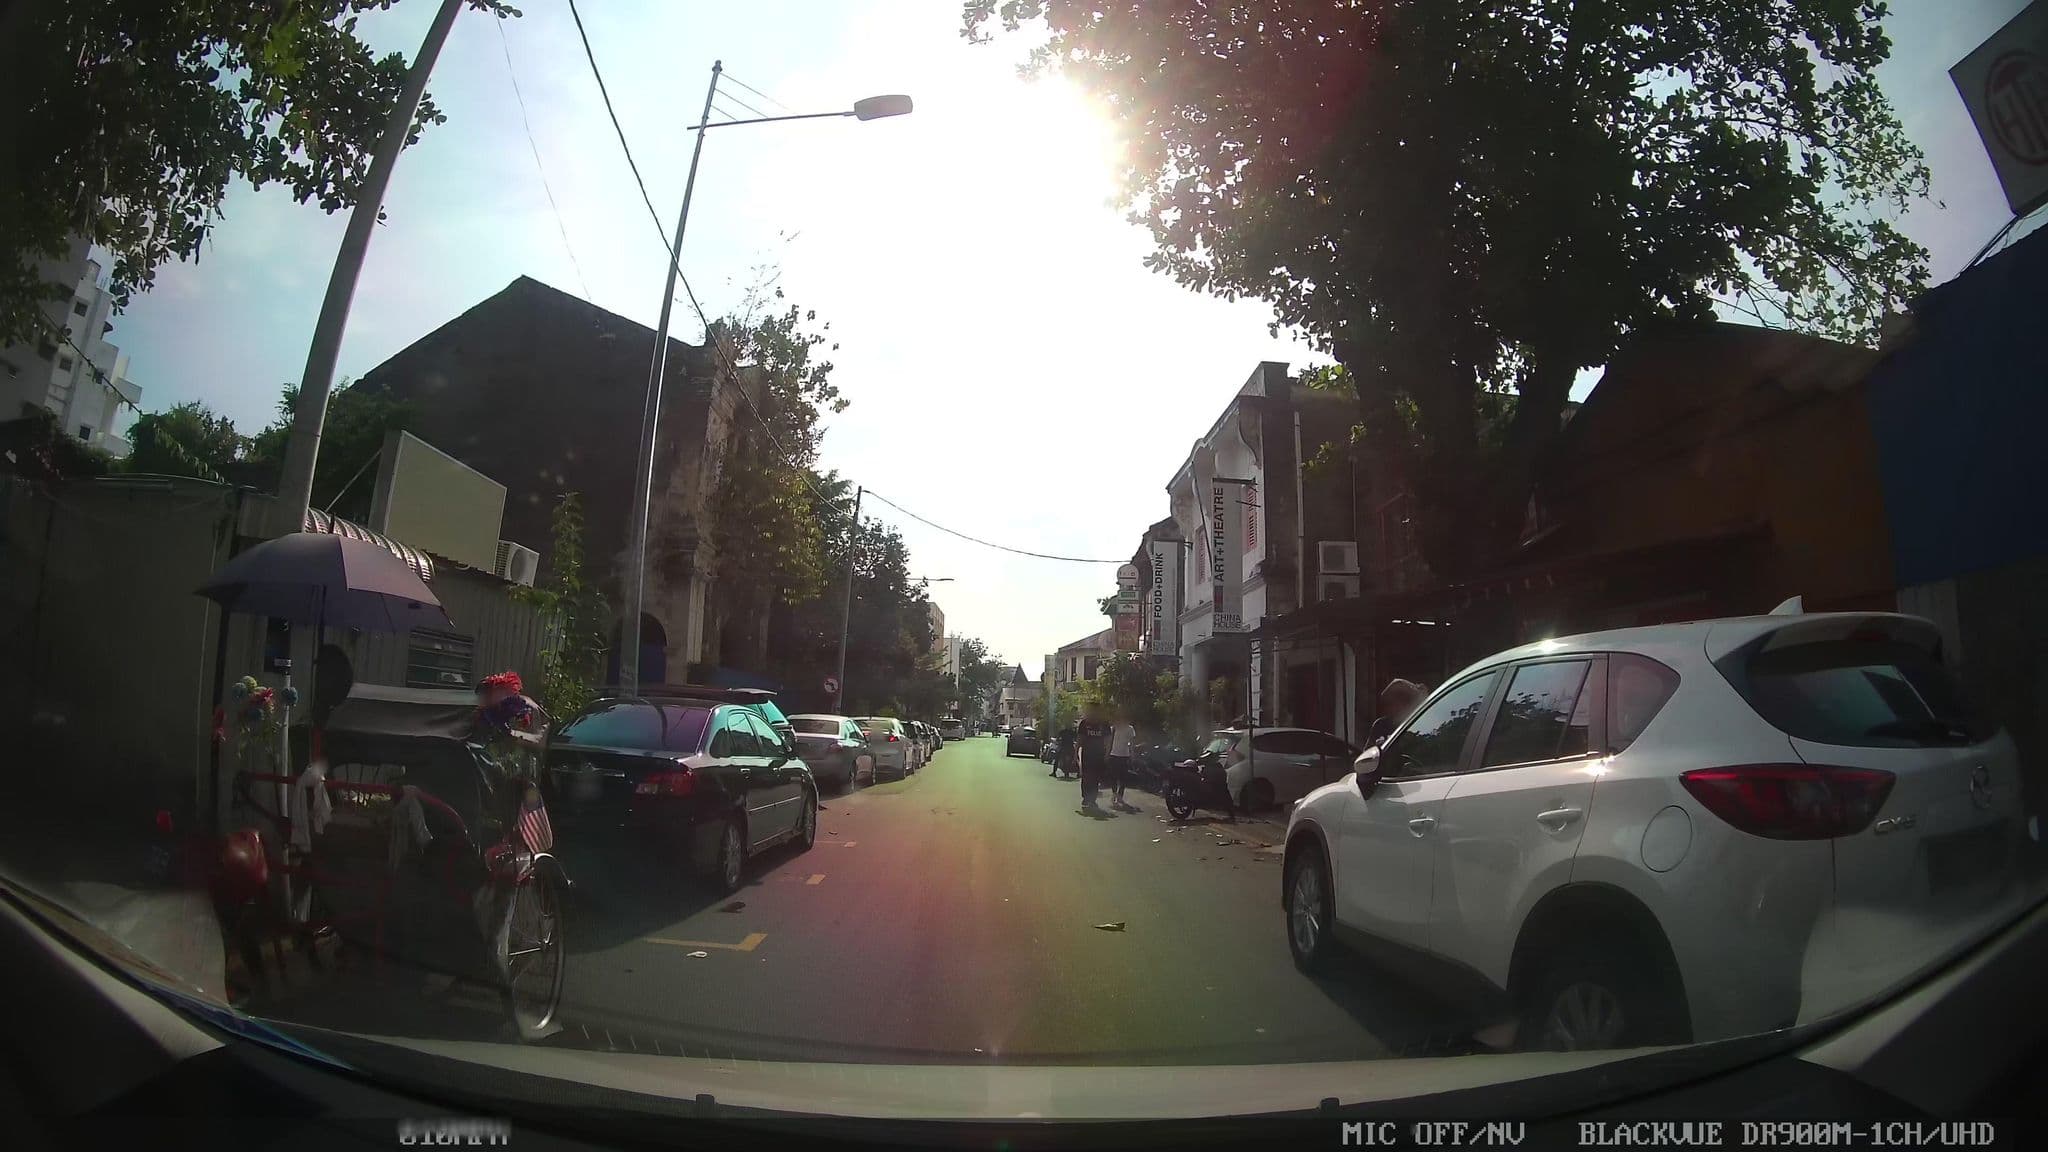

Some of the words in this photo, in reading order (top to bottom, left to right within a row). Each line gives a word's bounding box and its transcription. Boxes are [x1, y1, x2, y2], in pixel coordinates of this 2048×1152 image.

[1214, 487, 1224, 582] ART+THEATRE
[1154, 552, 1164, 618] FOOD+DRINK
[1213, 613, 1242, 623] CHINA
